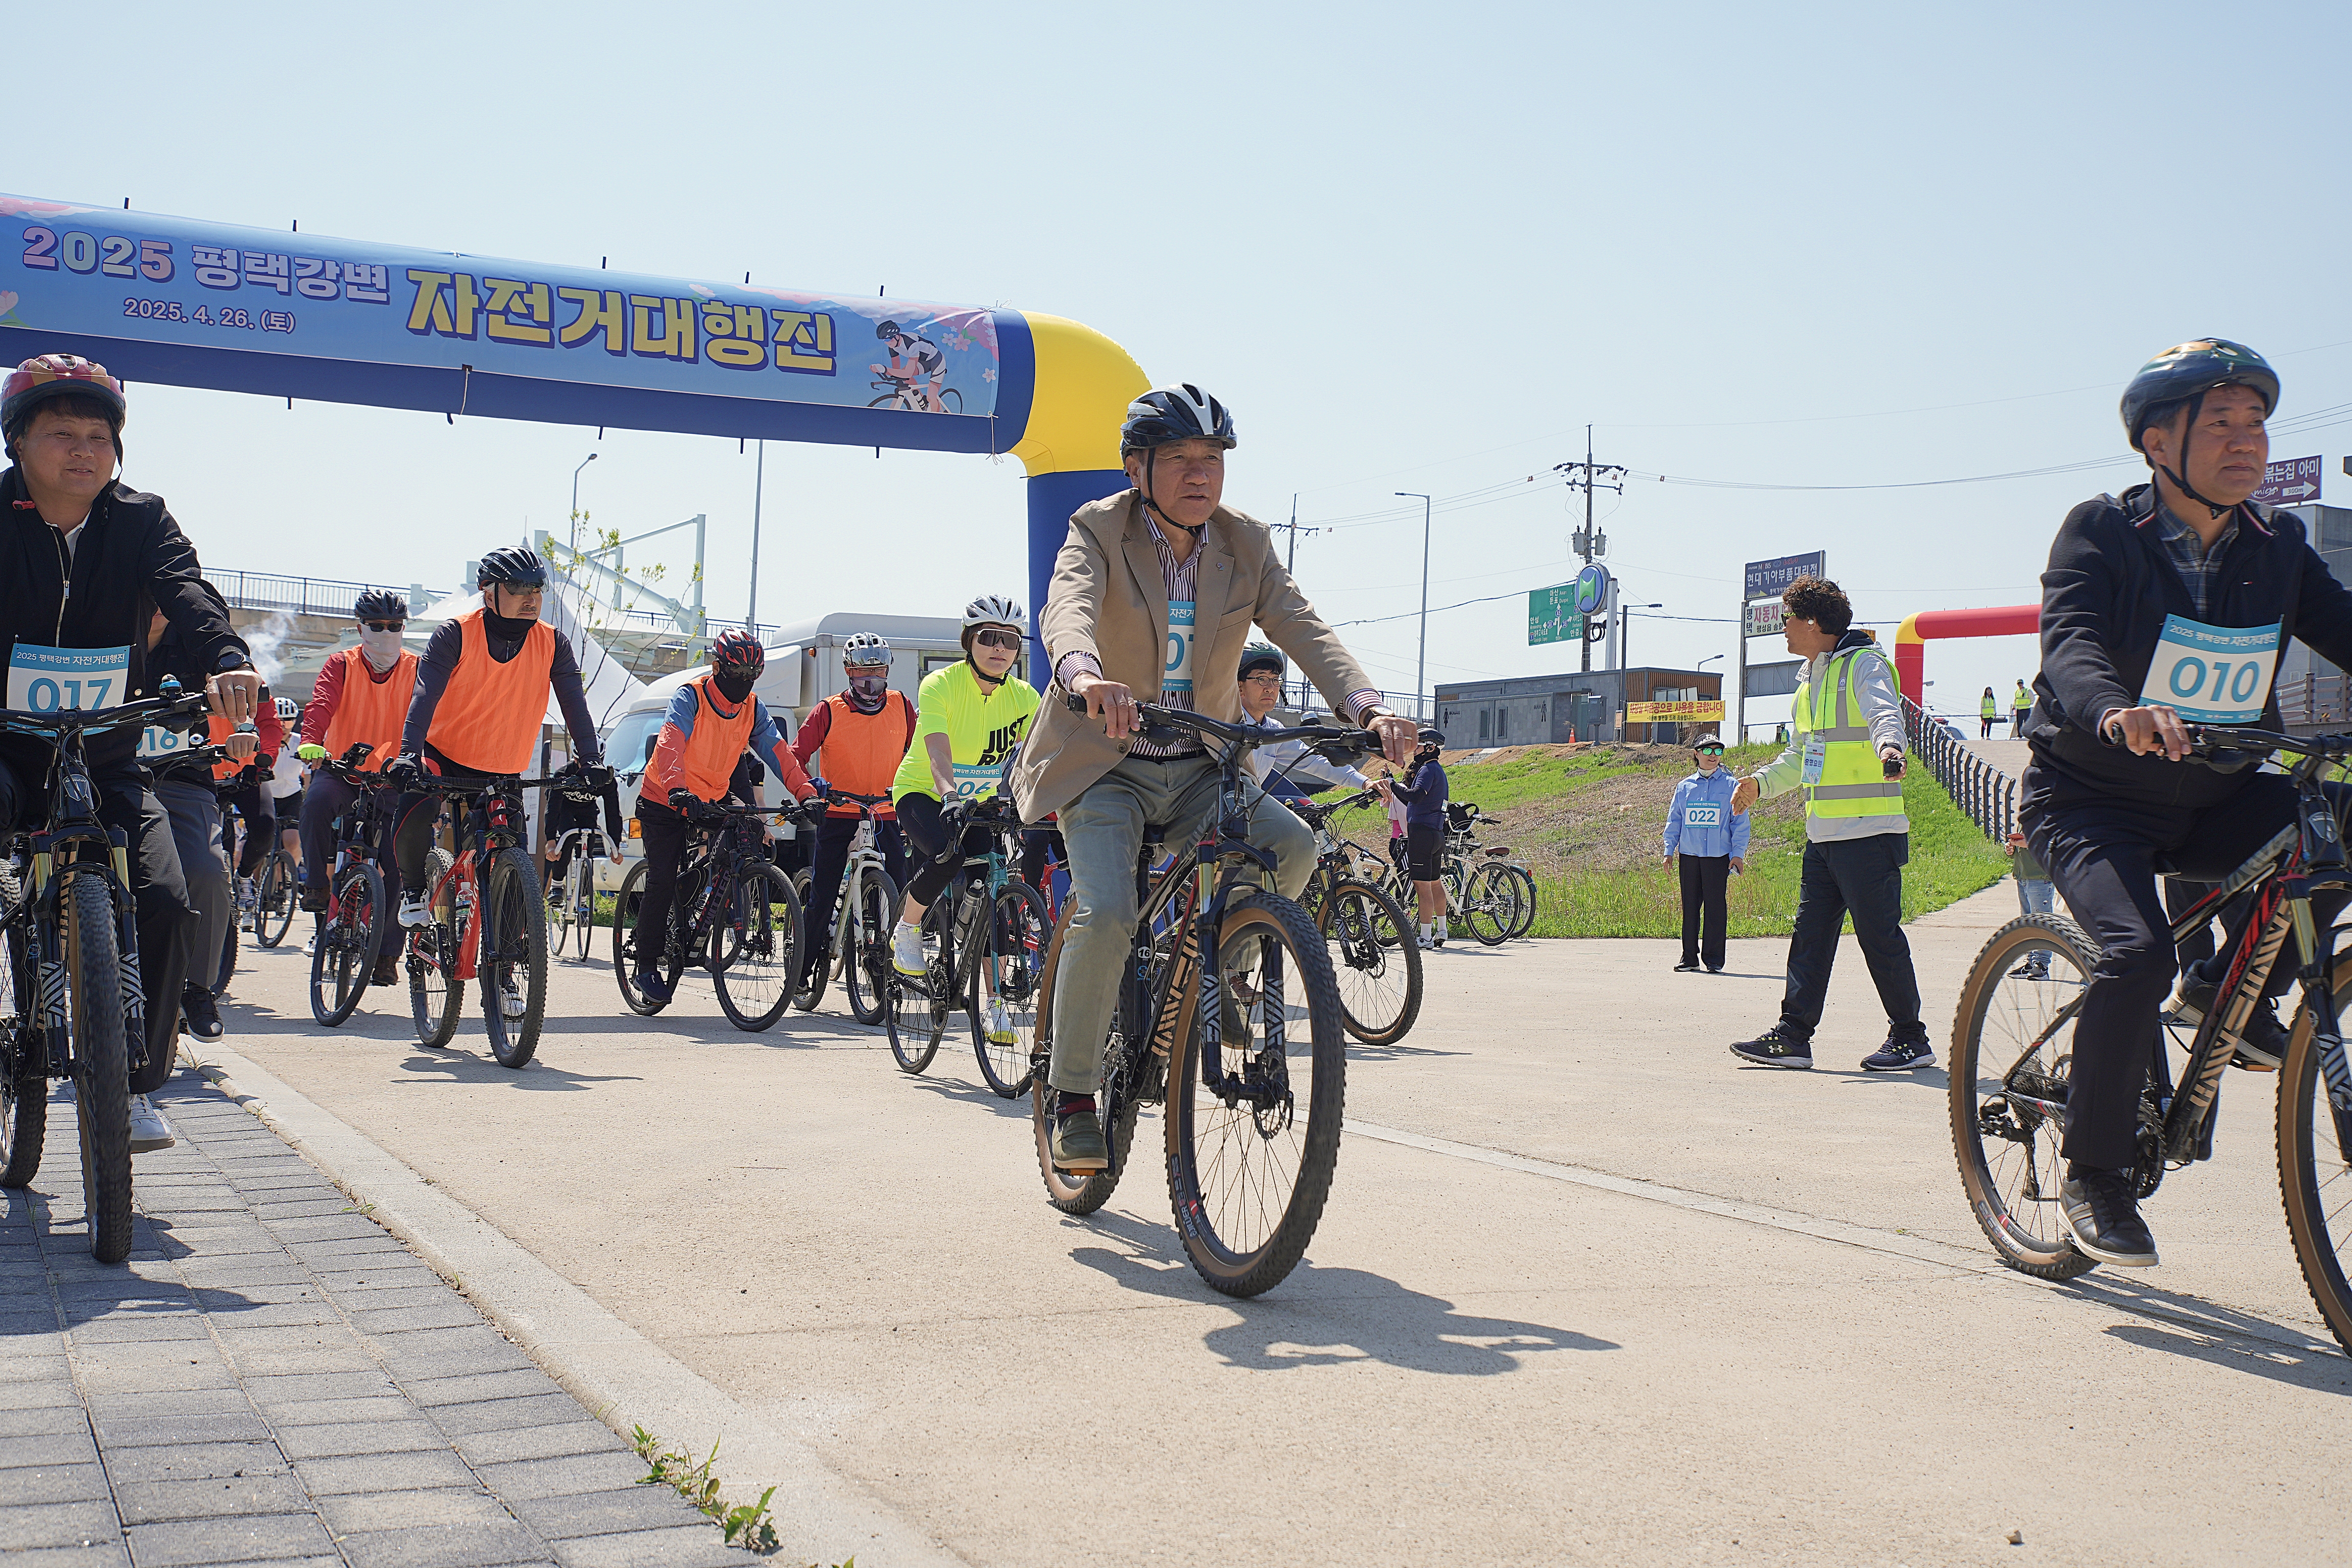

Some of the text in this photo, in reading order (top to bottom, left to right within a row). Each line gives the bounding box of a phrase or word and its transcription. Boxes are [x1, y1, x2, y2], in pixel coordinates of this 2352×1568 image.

[22, 227, 837, 377] 2025 평택강변 자전거대행진
[124, 298, 295, 334] 2025. 4. 26. (토)
[2262, 458, 2319, 484] 볶는집 아미
[1550, 597, 1558, 605] 둔포
[1530, 616, 1539, 624] 안성
[1754, 605, 1779, 623] 자동차
[1571, 628, 1579, 637] 안중
[2169, 625, 2194, 638] 2025
[17, 652, 125, 666] 2025 평택강변 자전거대행진
[2170, 657, 2260, 703] 010
[28, 678, 112, 712] 017
[96, 709, 122, 720] SARGENT
[1629, 701, 1723, 714] 화장실 미준공으로 사용을 금합니다
[17, 716, 45, 724] SARGENT
[983, 714, 1028, 754] JUST
[1805, 759, 1822, 767] 운영요원
[954, 781, 991, 796] 06
[1689, 810, 1716, 822] 022
[709, 830, 725, 864] ROCKBROS
